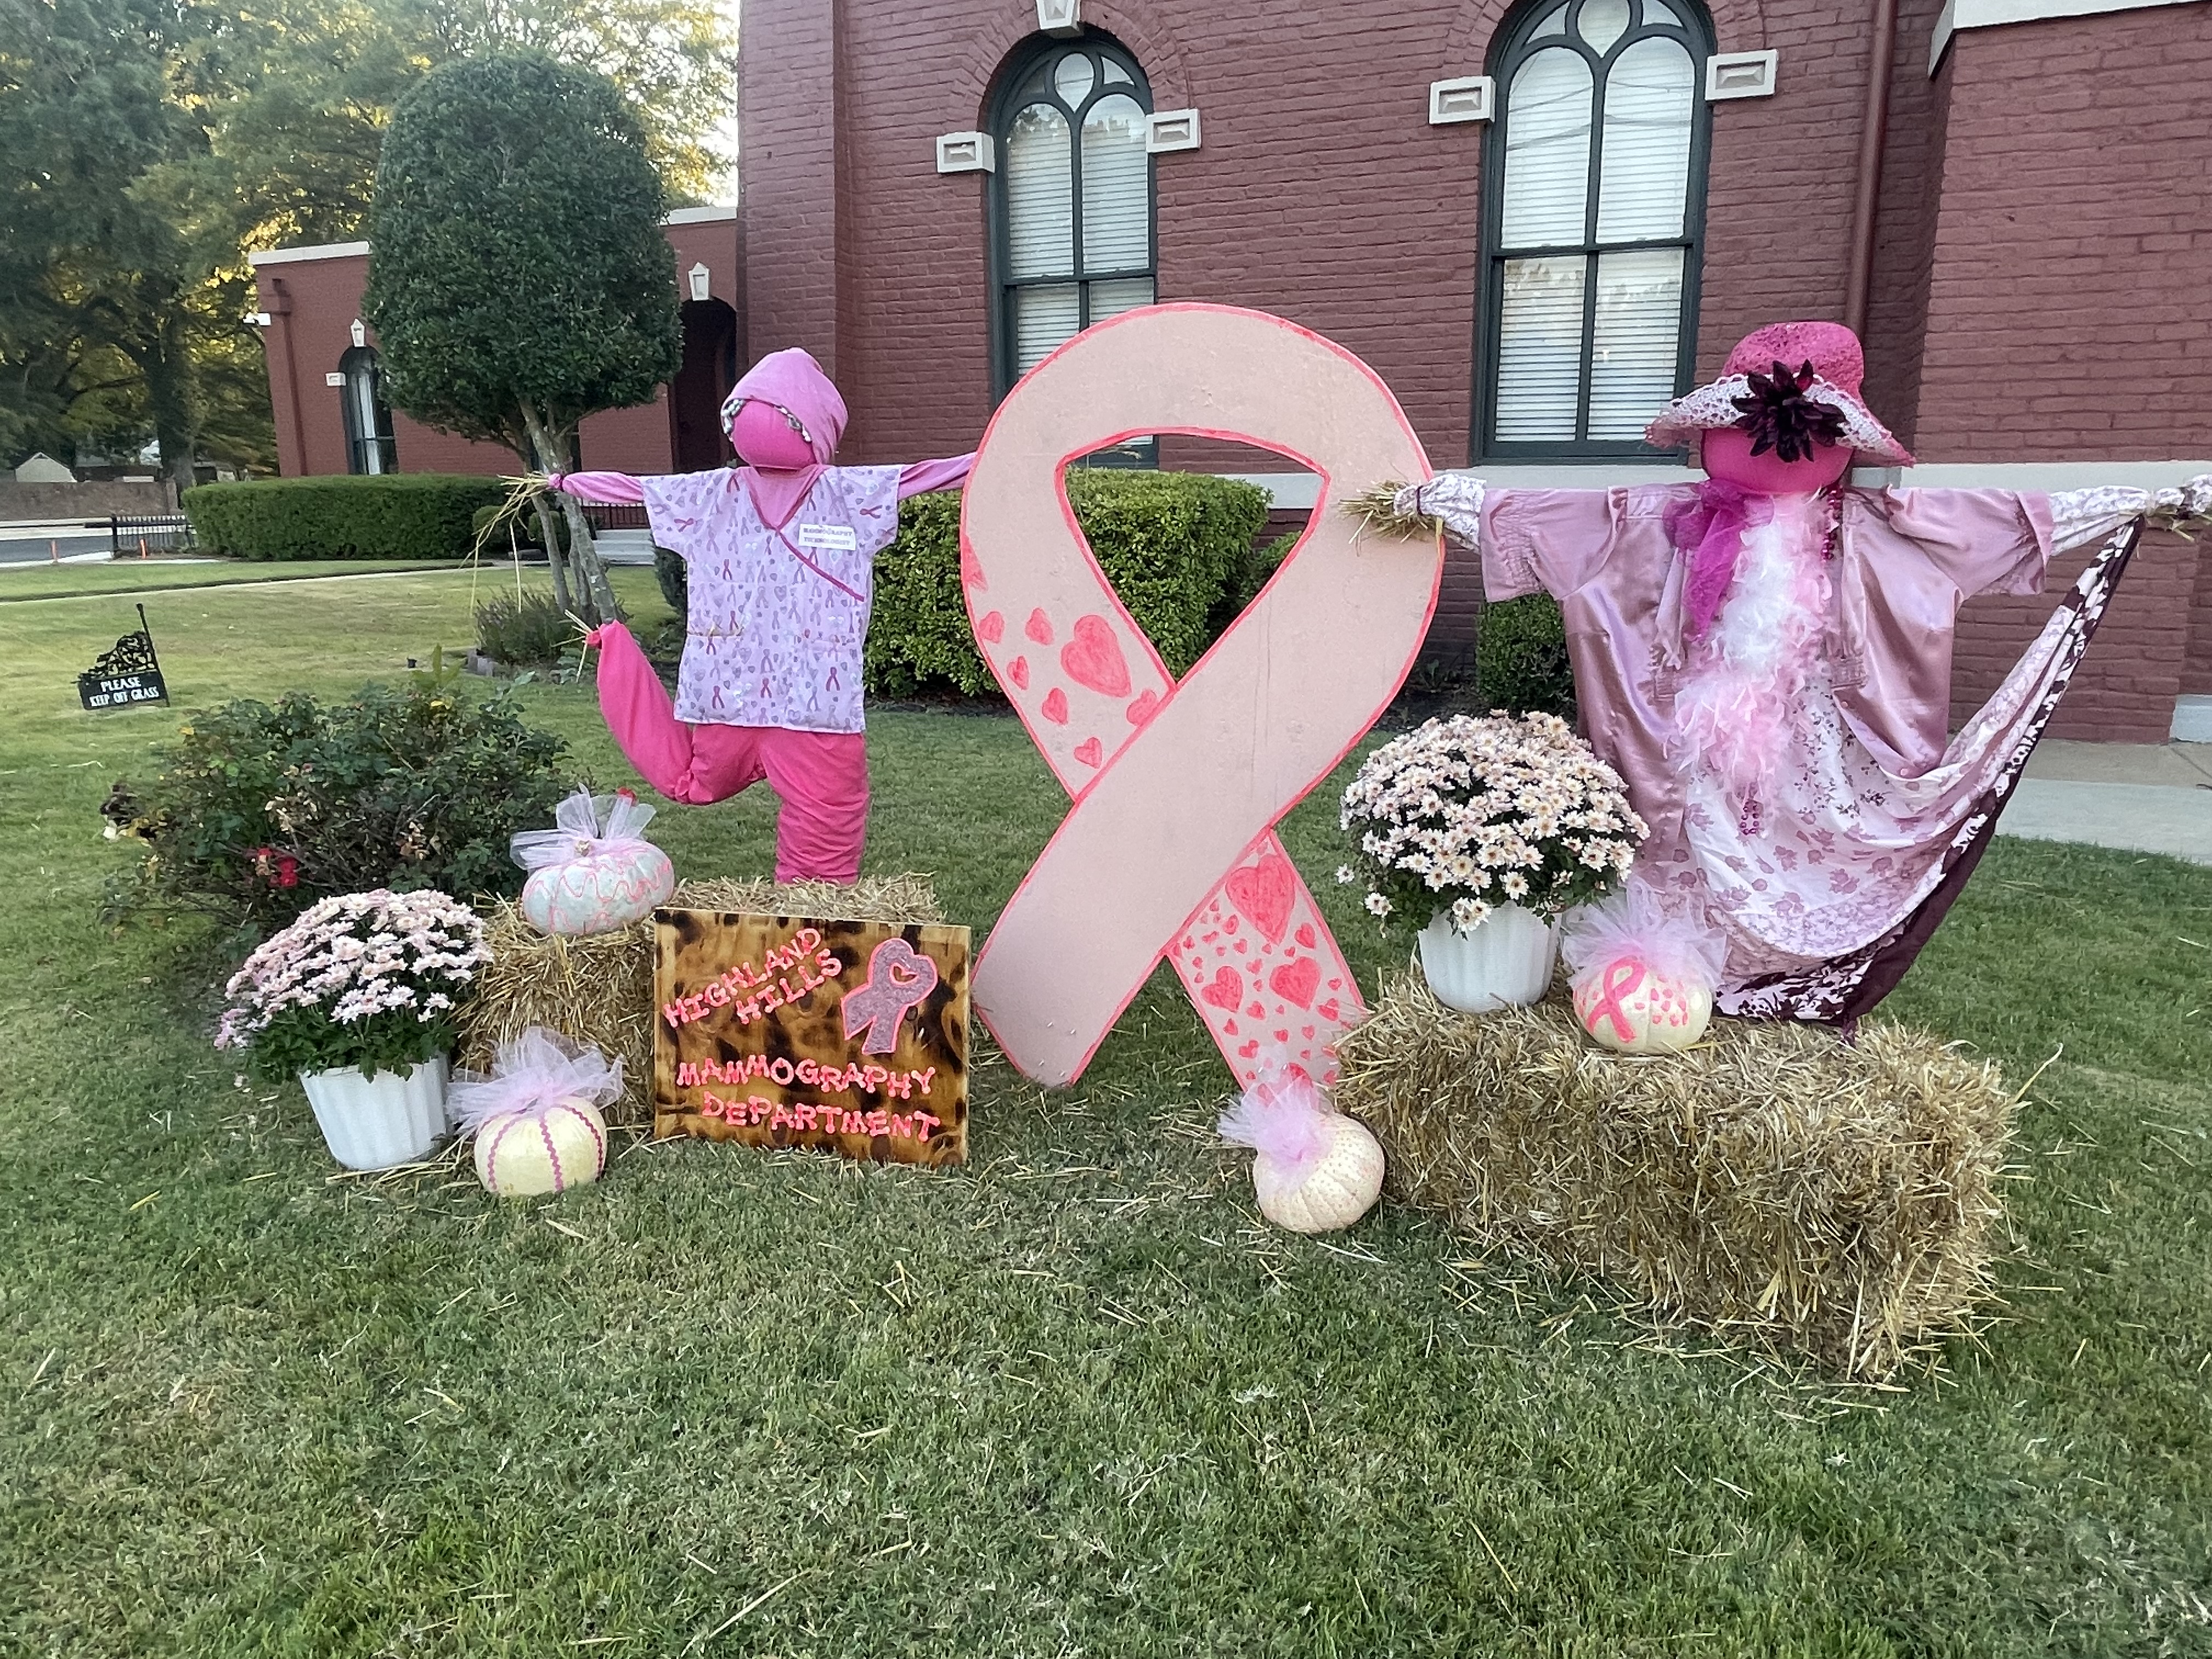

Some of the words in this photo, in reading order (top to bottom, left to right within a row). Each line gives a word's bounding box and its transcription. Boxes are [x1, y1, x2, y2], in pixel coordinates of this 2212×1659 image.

[100, 676, 142, 692] PLEASE
[131, 686, 160, 700] GRASS
[663, 928, 822, 1028] HIGHLAND
[736, 948, 842, 1025] HILLS
[676, 1054, 936, 1099] MAMMOGRAPHY
[702, 1091, 940, 1142] DEPARTMENT
